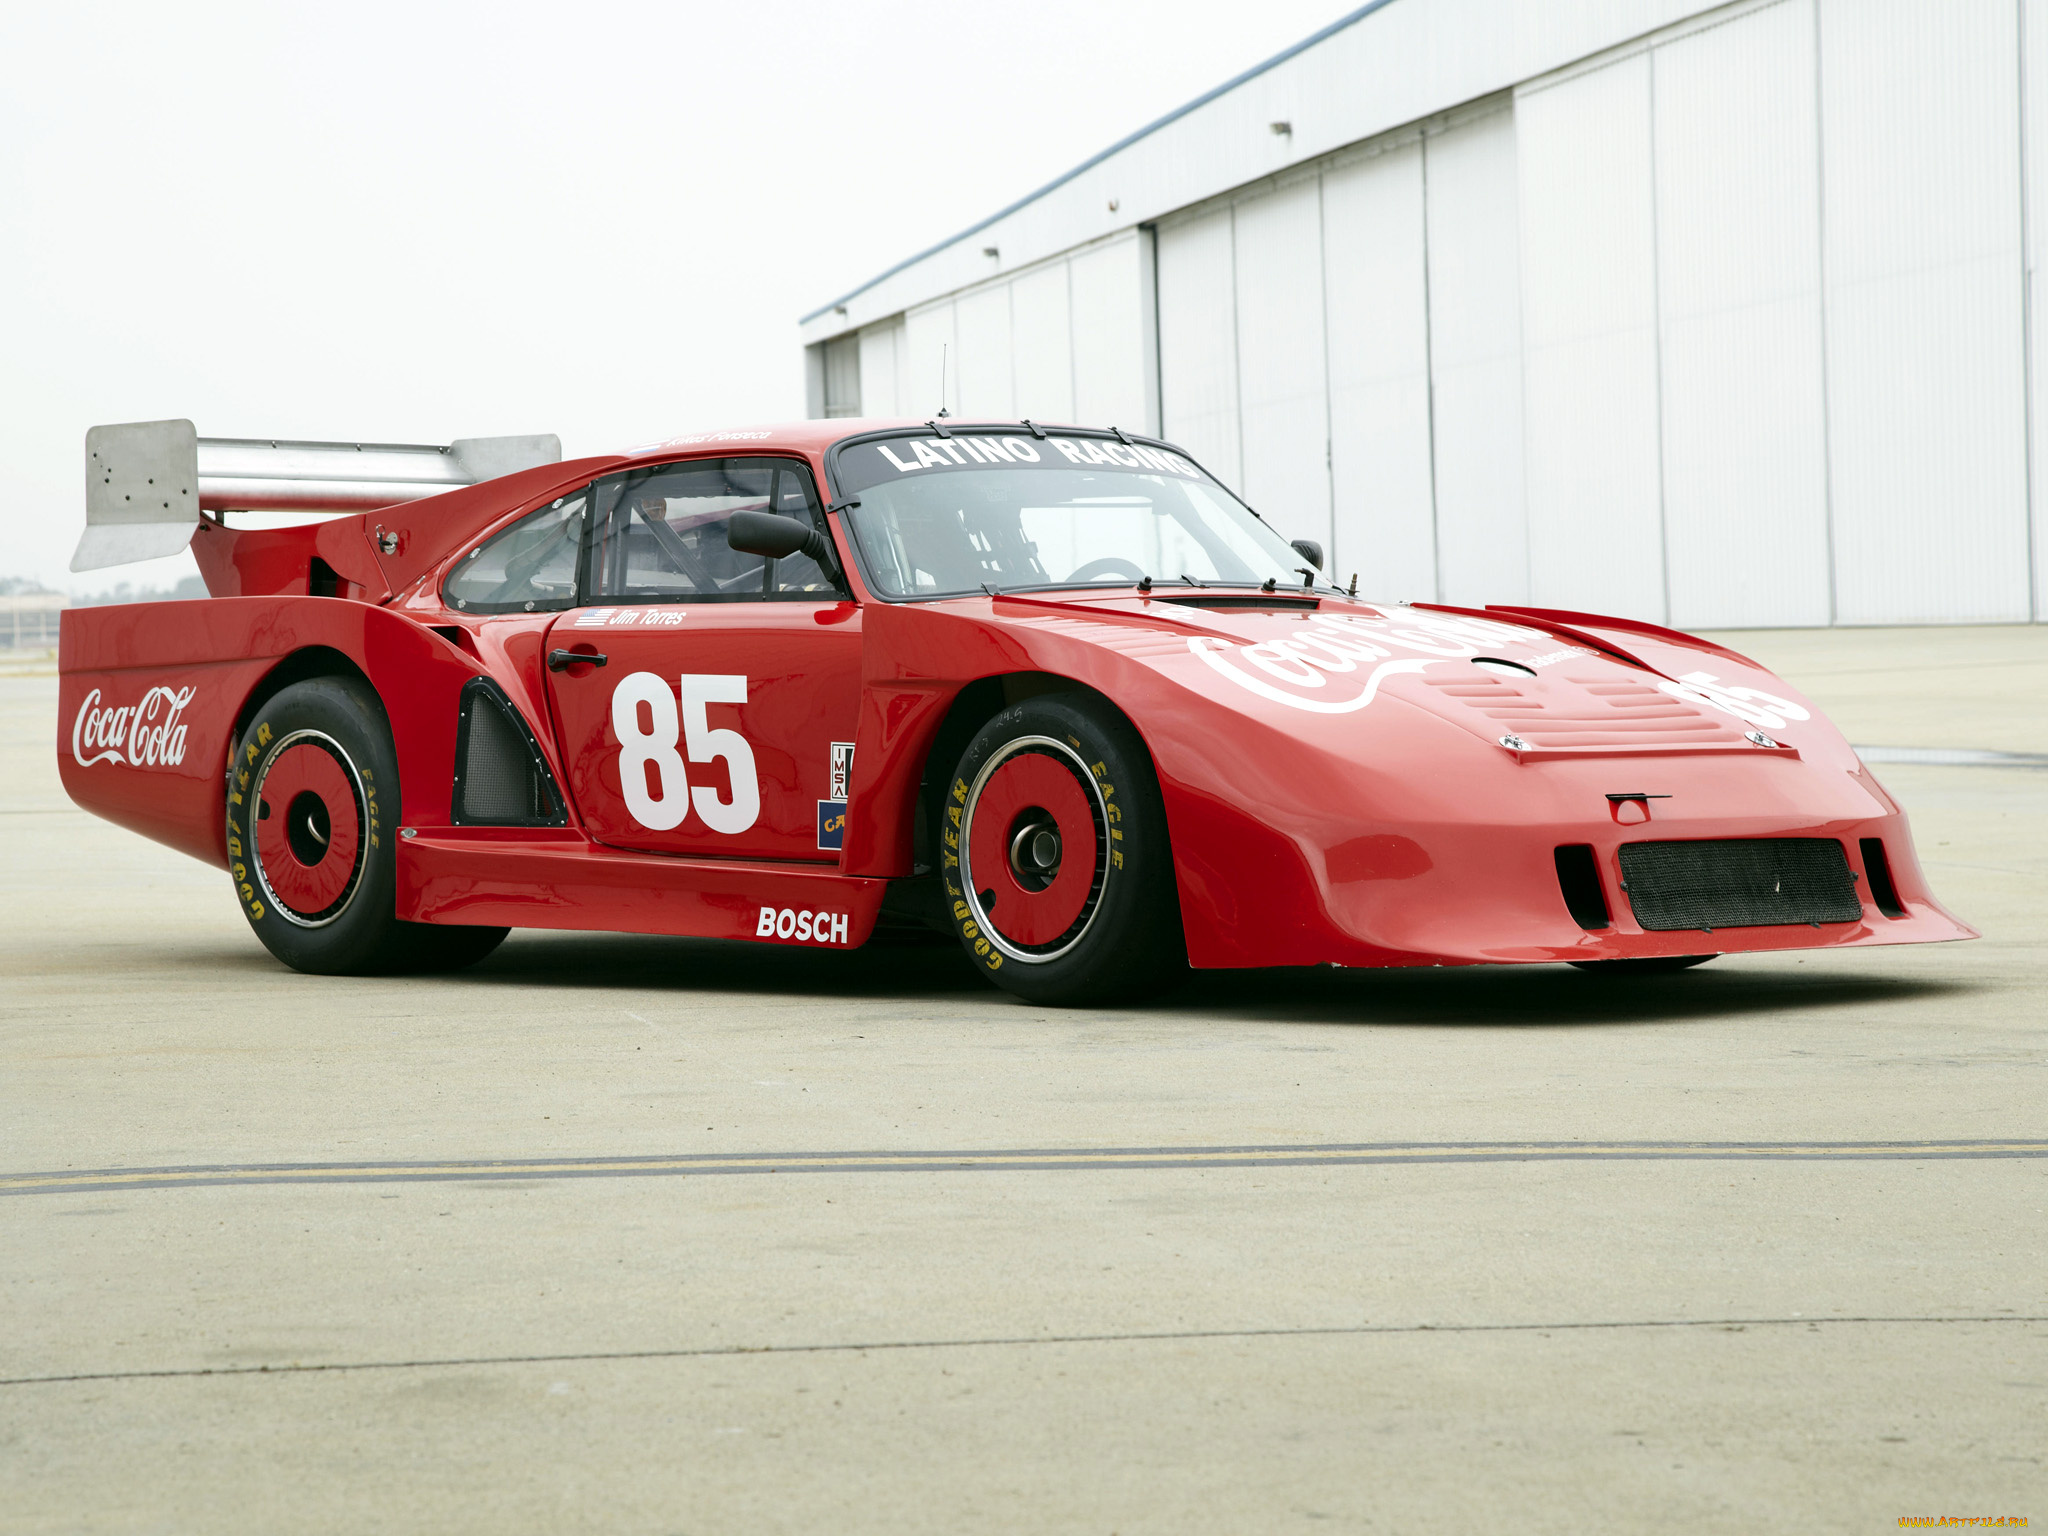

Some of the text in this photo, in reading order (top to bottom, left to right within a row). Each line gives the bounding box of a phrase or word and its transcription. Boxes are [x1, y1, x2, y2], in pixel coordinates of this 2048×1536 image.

[877, 437, 1200, 478] LATINO RACING
[609, 609, 687, 625] Jim Torres
[1186, 604, 1554, 714] Coca-Cola
[72, 686, 197, 767] Coca-Cola
[1657, 671, 1811, 729] 85
[612, 671, 760, 834] 85
[834, 748, 845, 796] IMSA
[1091, 760, 1124, 871] EAGLE
[756, 906, 848, 944] BOSCH
